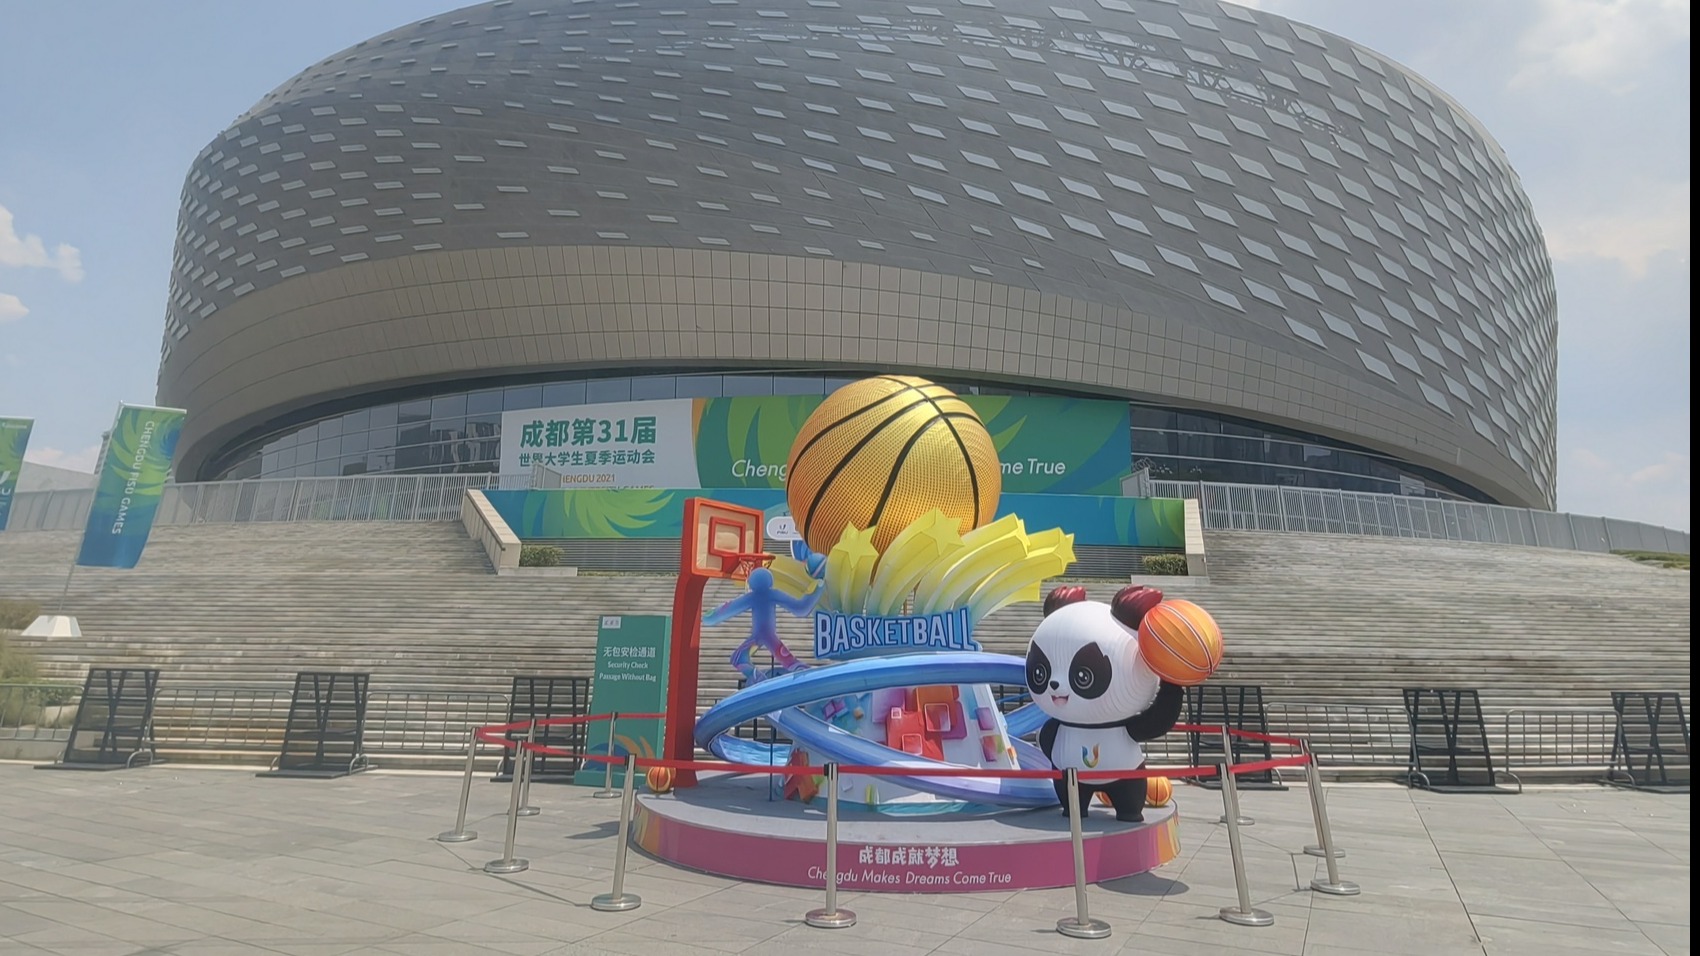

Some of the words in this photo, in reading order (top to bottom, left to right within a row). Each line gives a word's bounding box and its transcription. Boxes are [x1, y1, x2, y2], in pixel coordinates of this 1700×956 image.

[520, 416, 657, 448] 成都第31届
[132, 420, 155, 470] CHENGDU
[562, 474, 595, 484] ENGDU
[596, 473, 615, 483] 2021
[731, 459, 787, 482] Cheng
[1027, 458, 1066, 475] True
[124, 471, 140, 495] FISU
[111, 497, 131, 535] GAMES
[816, 607, 976, 657] BASKETBALL
[603, 646, 656, 658] 无包安检通道
[599, 672, 621, 681] Passage
[621, 673, 645, 681] Without
[645, 674, 657, 682] Bag
[607, 661, 630, 670] Security
[859, 845, 959, 869] 成都成就梦想
[807, 866, 858, 884] Chegdu
[861, 869, 901, 884] Makes
[905, 871, 950, 885] Dreams
[953, 871, 987, 885] Come
[988, 871, 1012, 883] True
